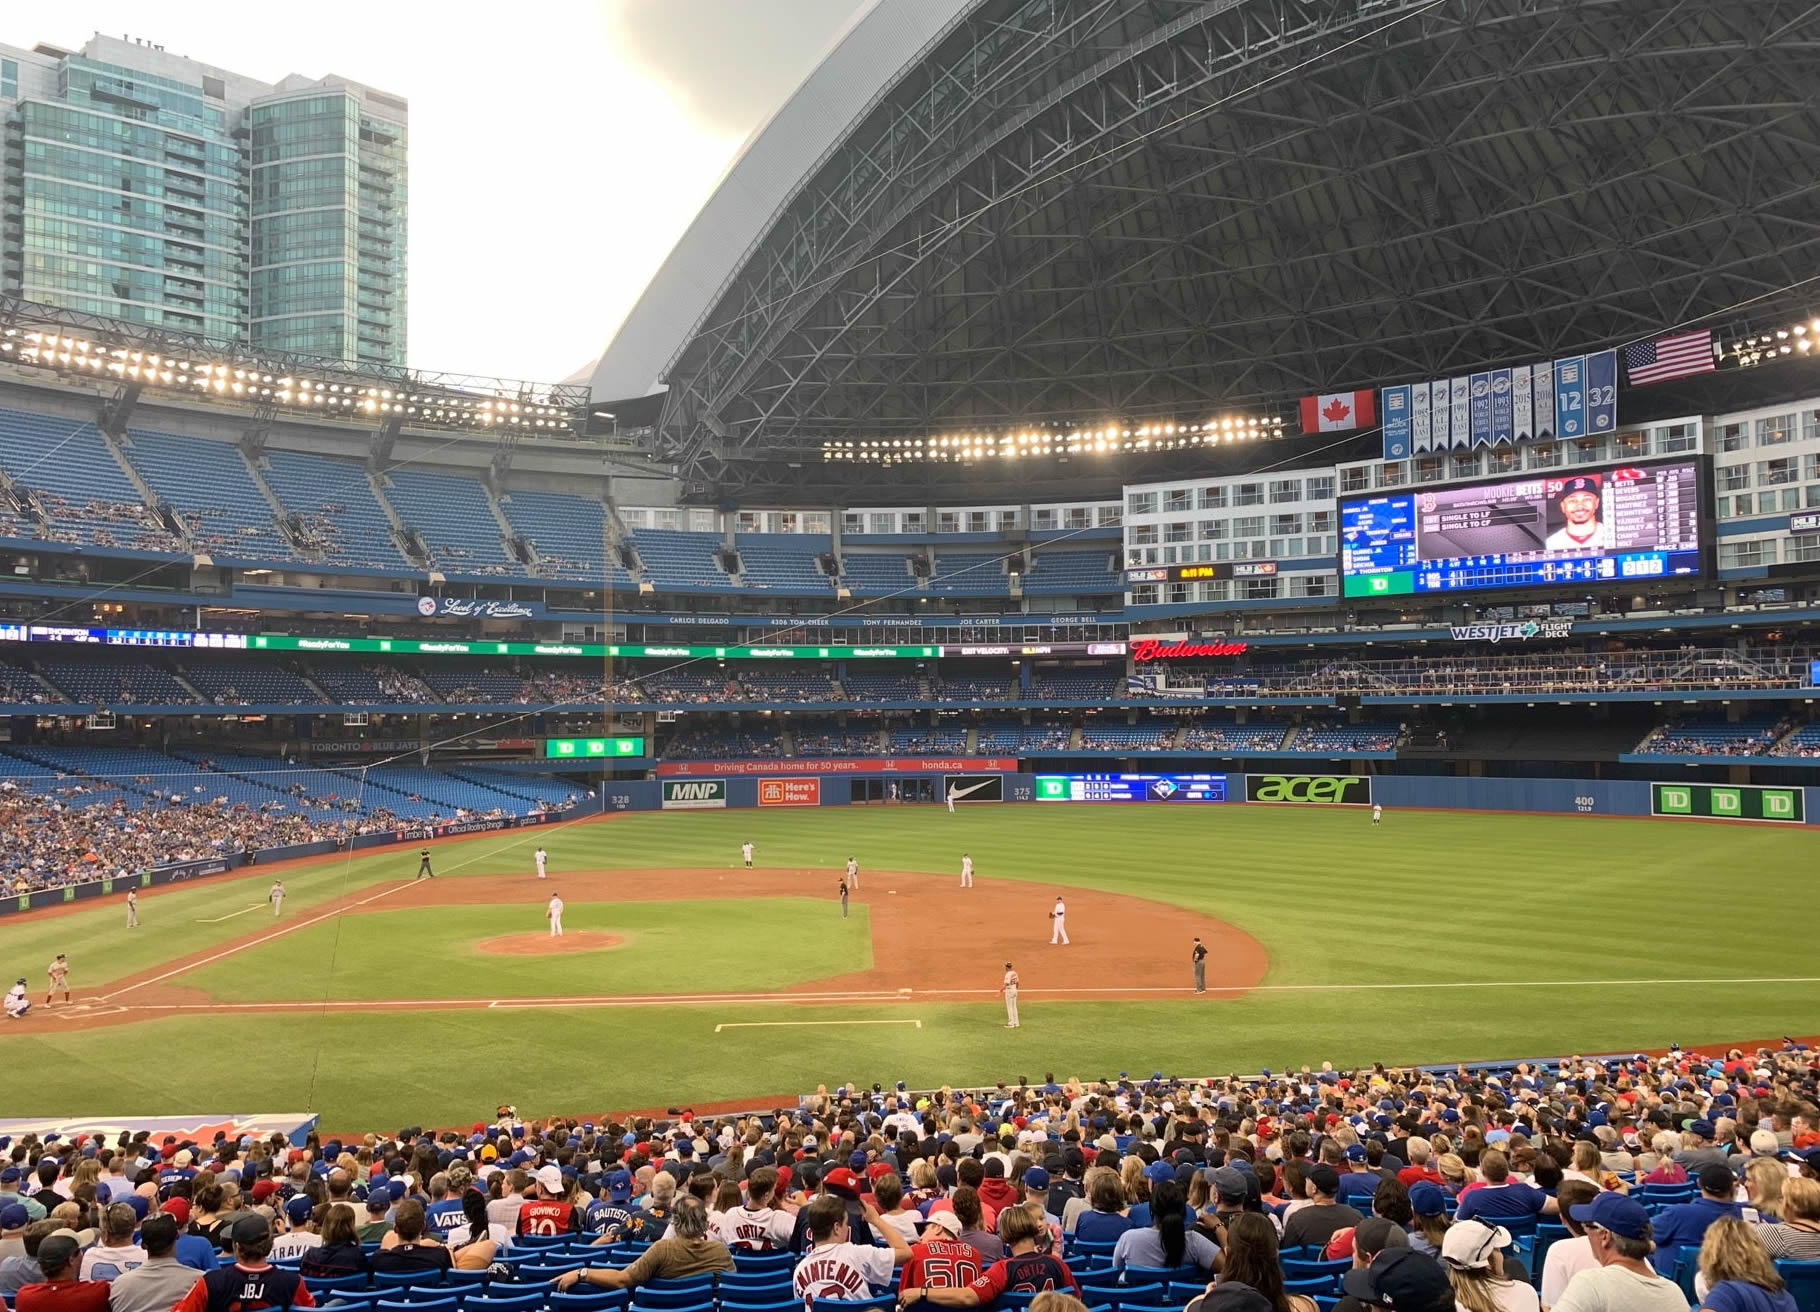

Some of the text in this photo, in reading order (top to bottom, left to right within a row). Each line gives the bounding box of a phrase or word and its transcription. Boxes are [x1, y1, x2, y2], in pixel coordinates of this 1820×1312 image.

[1494, 396, 1509, 408] 1993
[1515, 392, 1531, 405] 2015
[1560, 391, 1581, 411] 12
[1589, 385, 1615, 407] 32
[1474, 399, 1489, 411] 1992
[1484, 486, 1515, 499] MOOKIE
[1516, 483, 1543, 496] BETTS
[1547, 481, 1563, 493] 50
[1441, 513, 1468, 521] SINGLE
[1441, 522, 1468, 530] SINGLE
[1198, 567, 1214, 577] PM
[1626, 564, 1633, 573] 2
[1652, 562, 1659, 571] 2
[1369, 578, 1387, 591] TD
[440, 598, 533, 617] Level of Excellence
[698, 617, 729, 625] DELGADO
[1541, 622, 1573, 631] FLIGHT
[1451, 625, 1519, 642] WESTJET
[1545, 630, 1569, 638] DECK
[1129, 639, 1248, 662] Budweiser
[312, 743, 361, 752] TORONTO
[559, 742, 573, 753] TD
[588, 741, 603, 753] TD
[619, 741, 633, 752] TD
[714, 760, 963, 773] Driving Canada home for 50 years. honda.ca
[671, 783, 718, 800] MNP
[785, 782, 816, 792] Here's
[1014, 787, 1031, 796] 375
[1043, 782, 1063, 795] TD
[1256, 777, 1360, 802] acer
[785, 791, 810, 801] How.
[1575, 796, 1594, 806] 400
[1664, 791, 1689, 808] TD
[1714, 793, 1739, 810] TD
[1765, 795, 1791, 813] TD
[449, 825, 467, 834] Official
[467, 822, 486, 832] Roofing
[529, 1207, 561, 1217] GIOVINCO
[594, 1207, 632, 1222] BAUTISTA
[433, 1210, 469, 1228] VANS
[529, 1218, 557, 1235] 10
[735, 1224, 766, 1240] ORTIZ
[271, 1244, 307, 1260] TRAVI
[927, 1241, 973, 1258] BETTS
[923, 1258, 979, 1289] 50
[1016, 1263, 1047, 1280] ORTIZ
[240, 1283, 265, 1299] JBJ
